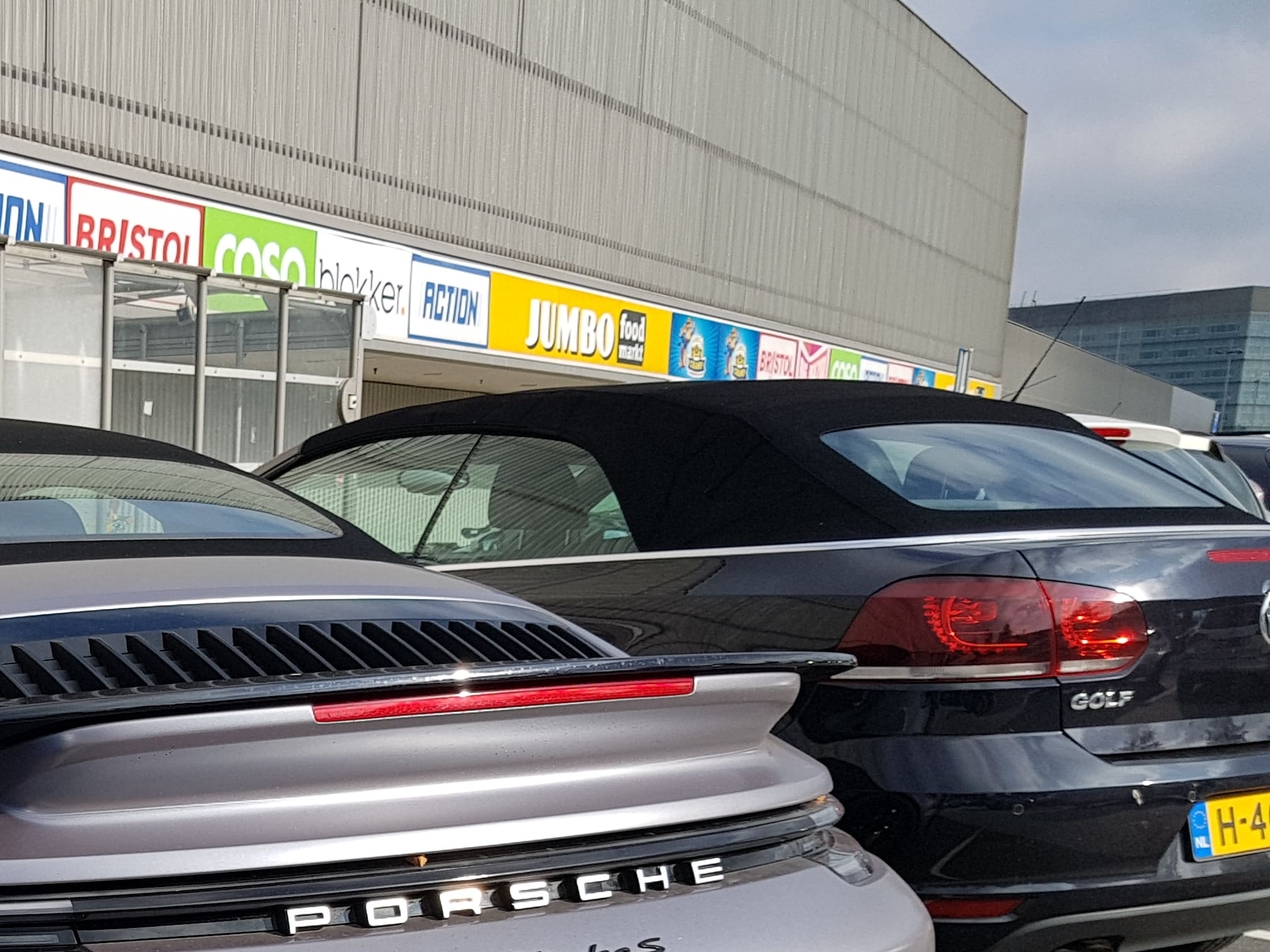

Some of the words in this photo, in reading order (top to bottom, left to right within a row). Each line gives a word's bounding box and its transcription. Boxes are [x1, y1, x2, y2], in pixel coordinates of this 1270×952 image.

[422, 281, 479, 327] ACTION
[524, 298, 616, 360] JUMBO
[619, 312, 646, 342] food
[618, 344, 644, 362] markt
[759, 350, 794, 377] BRISTOL
[1070, 690, 1135, 711] GOLF
[1216, 801, 1270, 846] H-4
[1194, 835, 1210, 849] NL
[286, 857, 725, 935] PORSCHE
